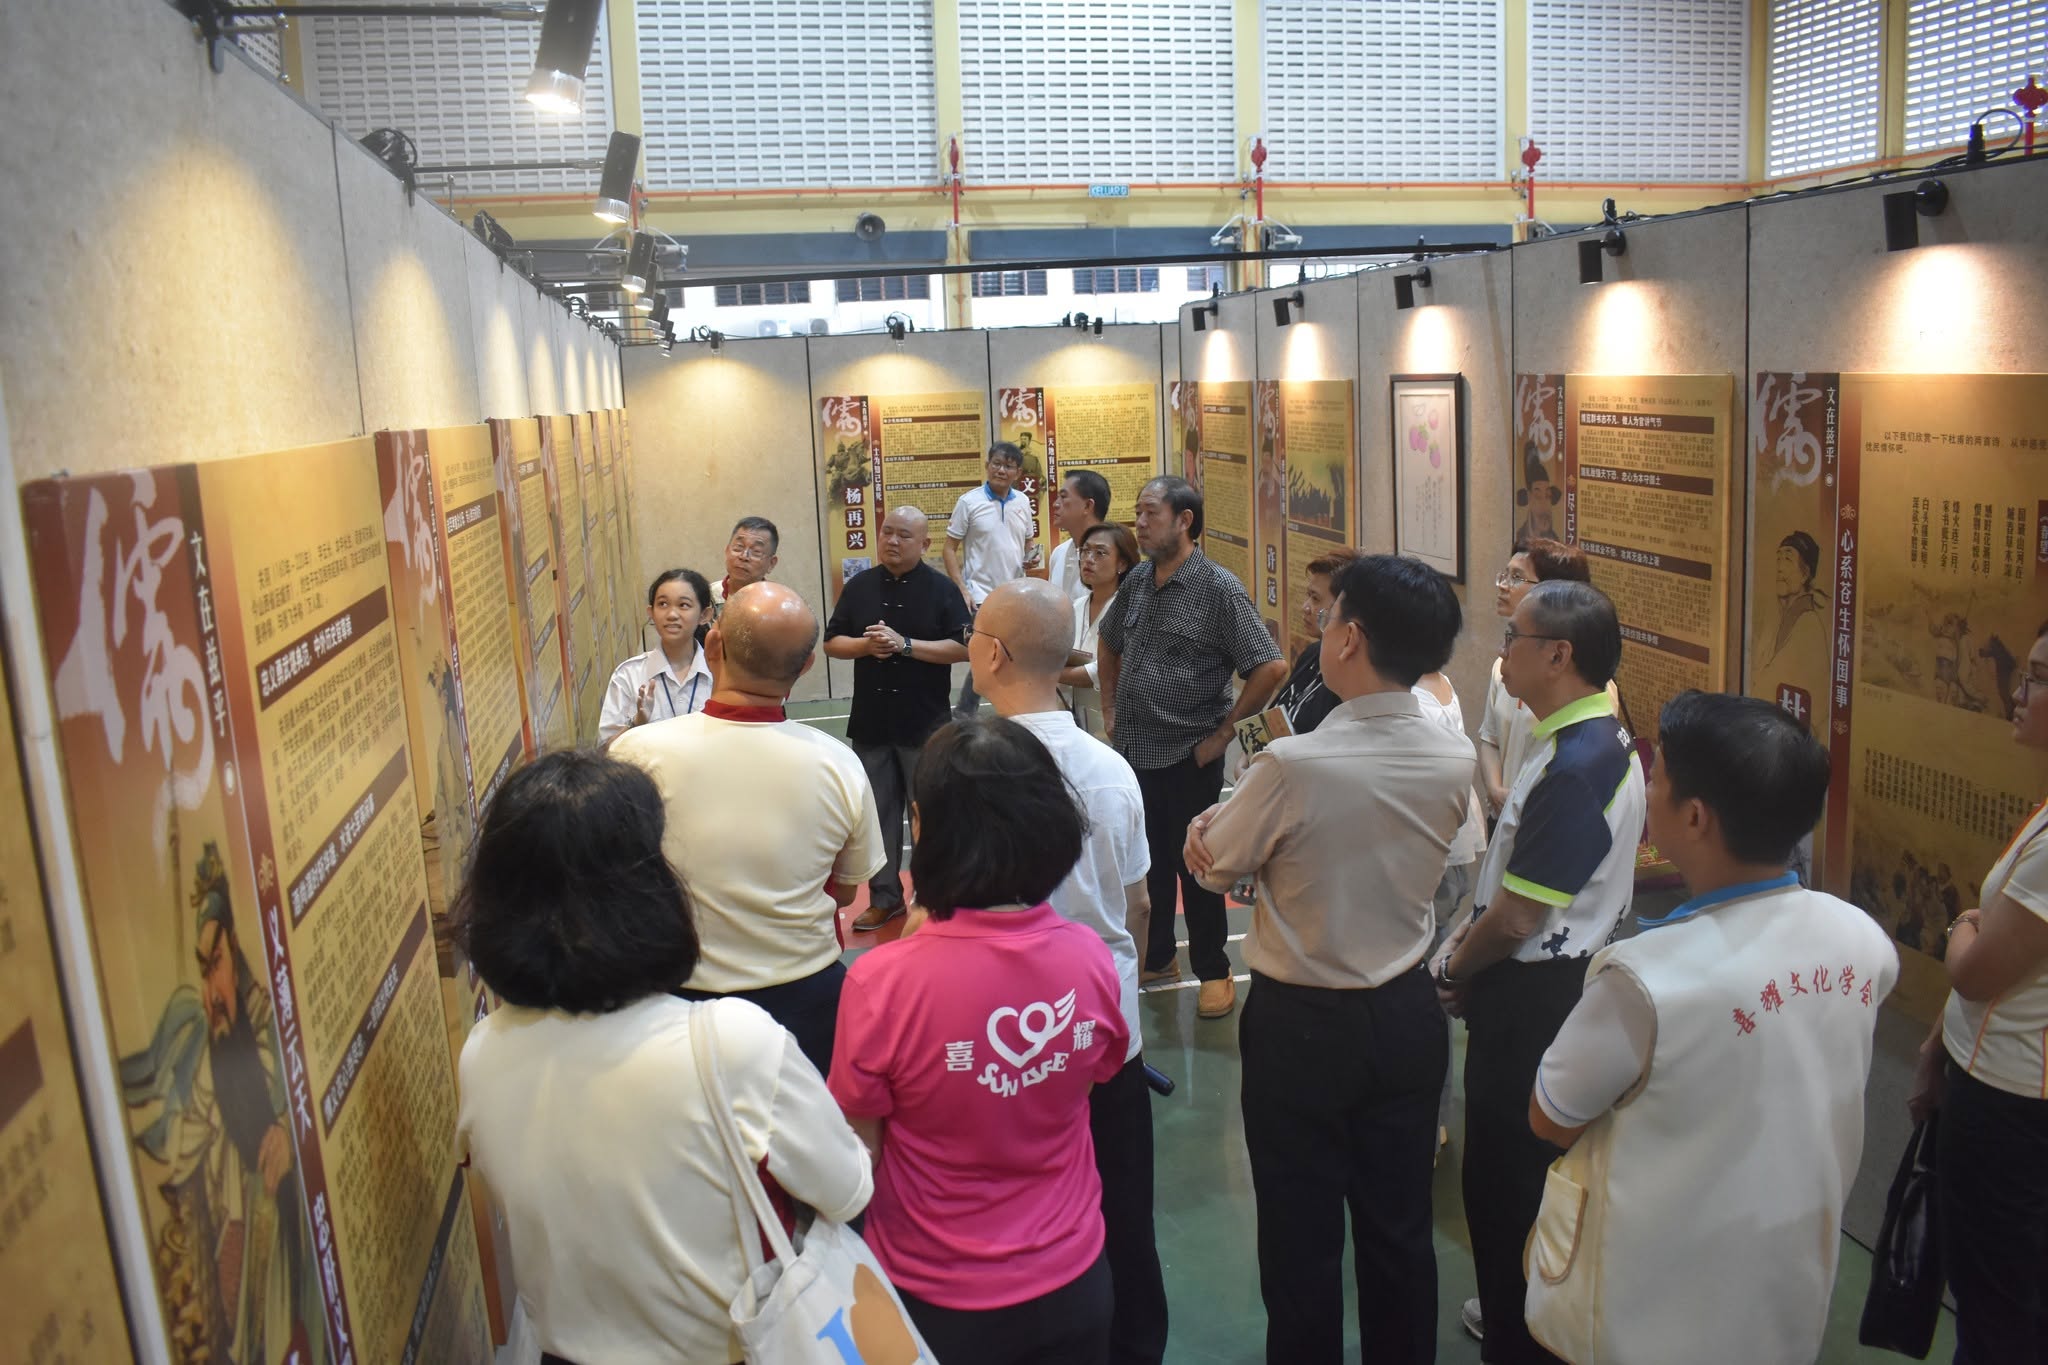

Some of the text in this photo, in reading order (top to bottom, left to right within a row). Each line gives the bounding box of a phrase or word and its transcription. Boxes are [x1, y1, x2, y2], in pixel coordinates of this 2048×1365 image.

[1825, 386, 1837, 464] 文在兹乎
[845, 487, 864, 548] 杨再兴
[190, 530, 227, 738] 文在兹乎
[1836, 528, 1854, 708] 心系苍生怀国事
[944, 1019, 1097, 1072] 喜 耀
